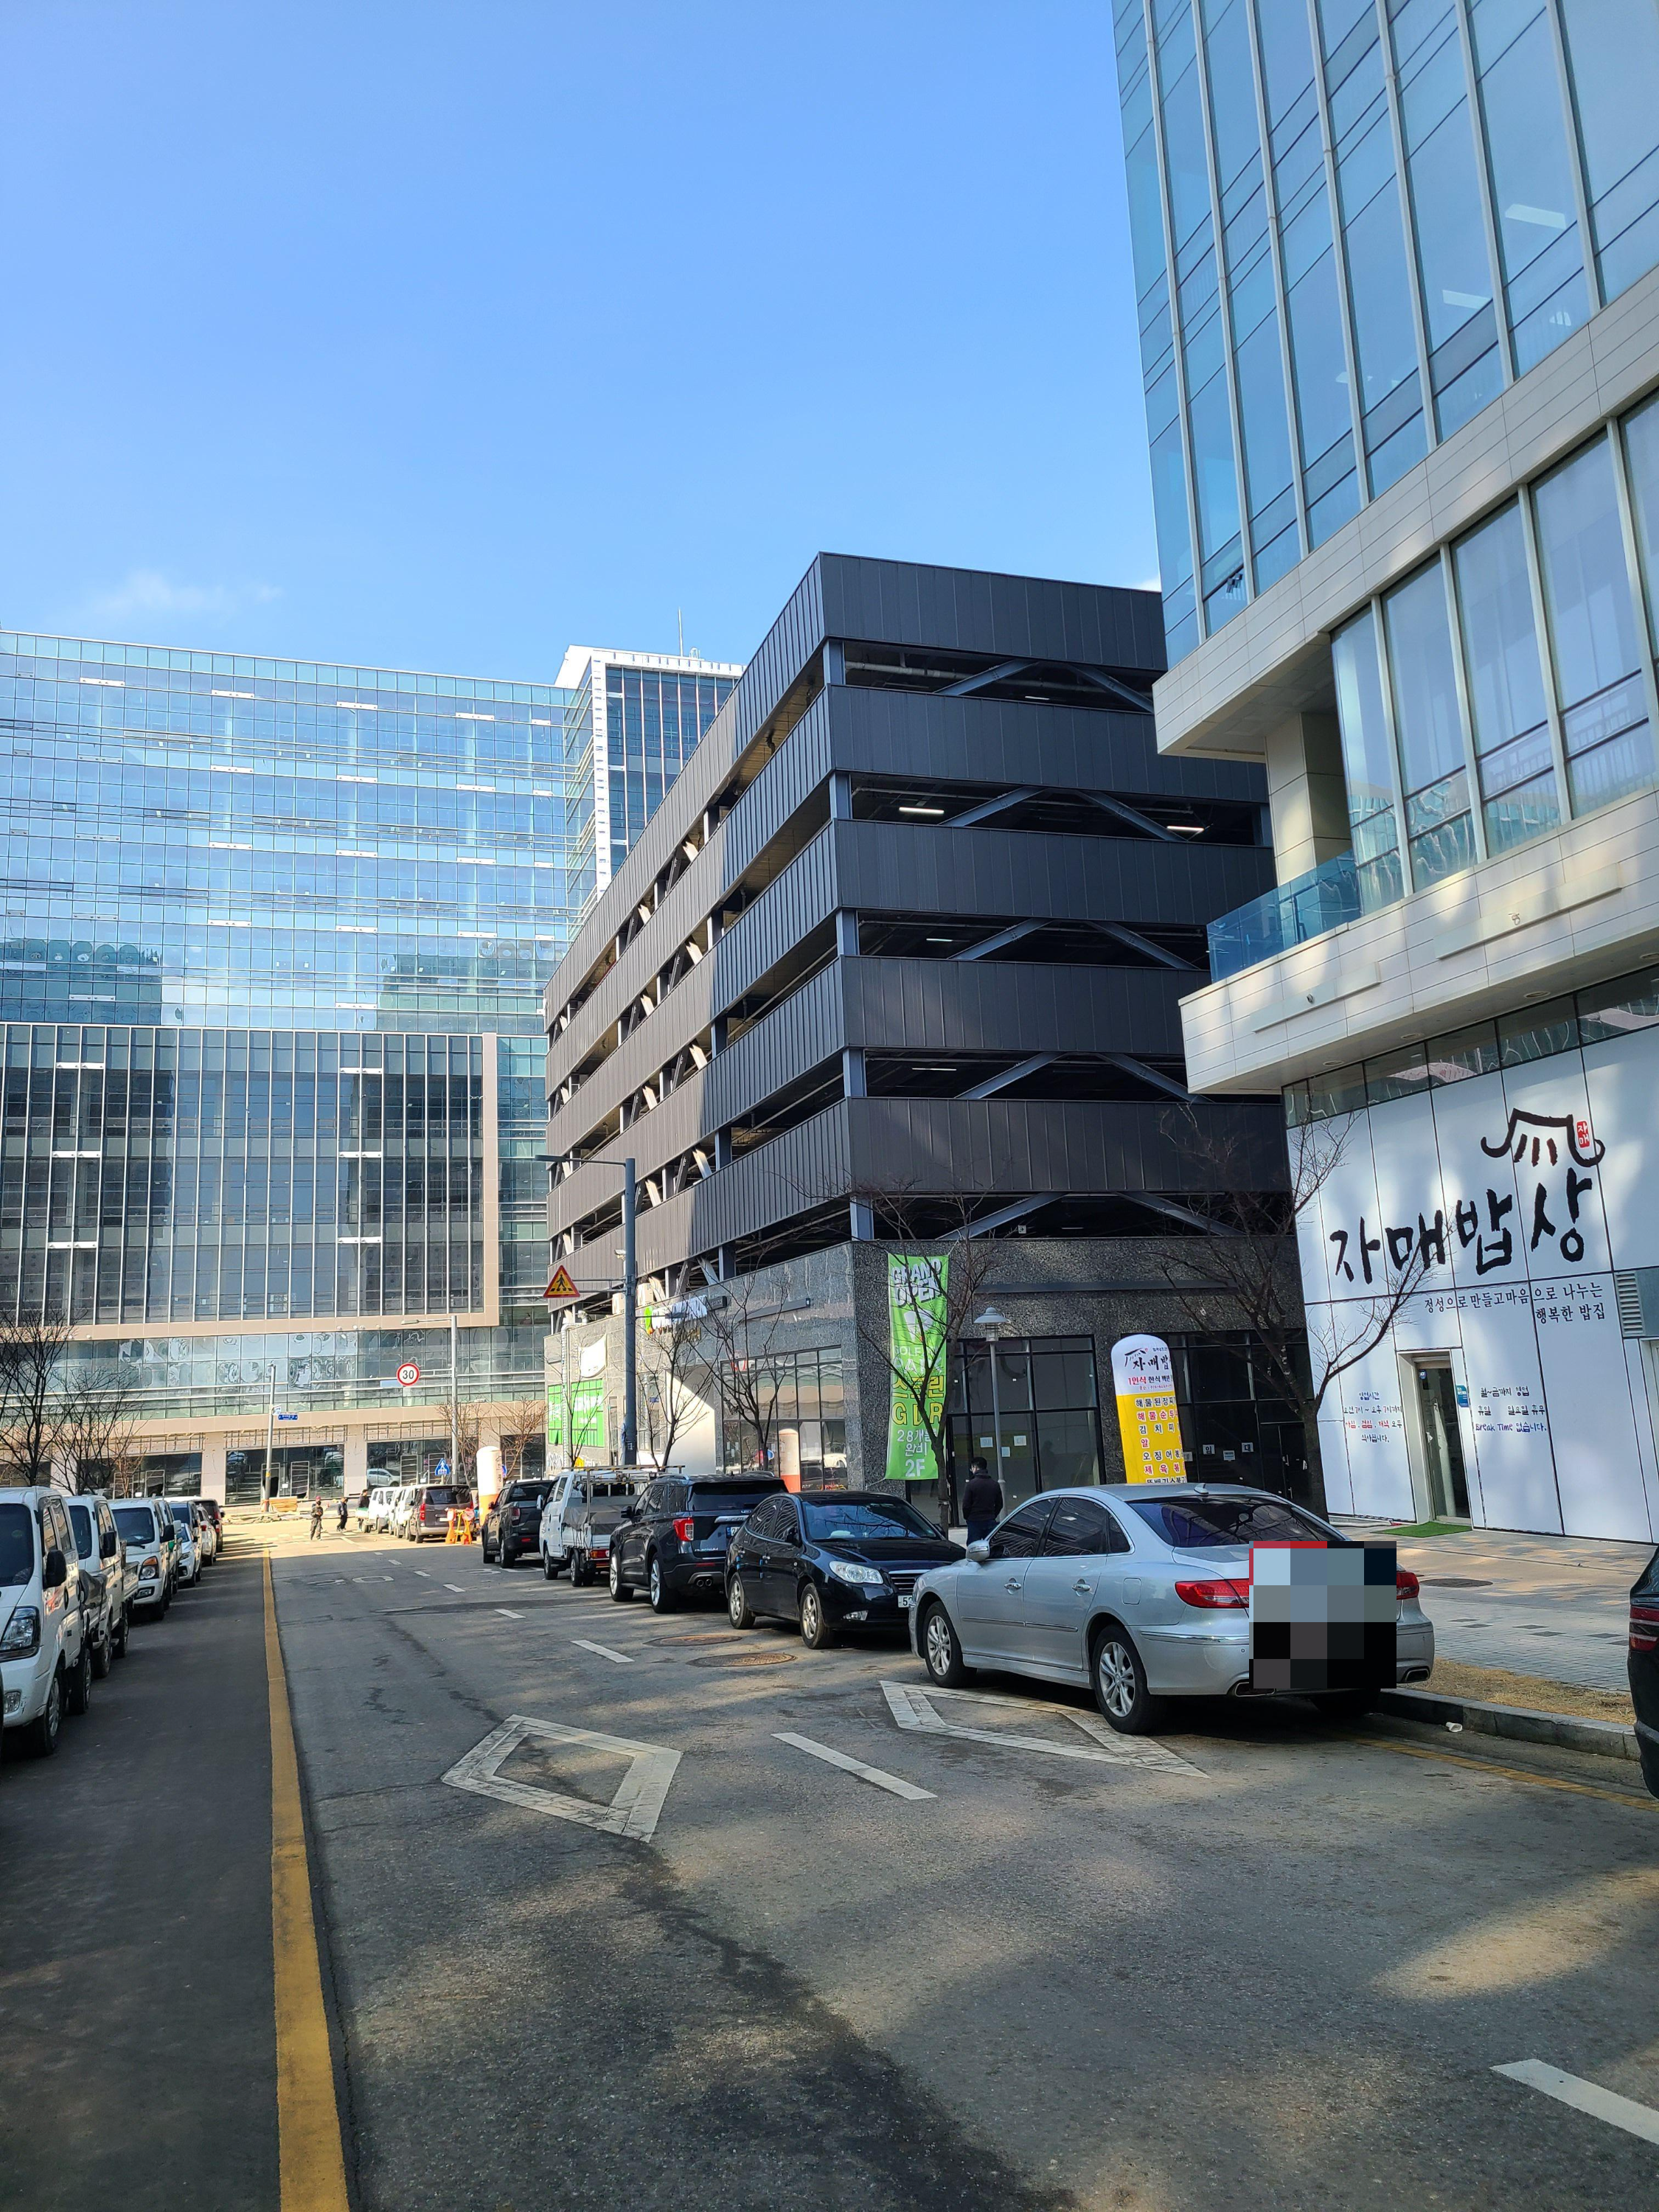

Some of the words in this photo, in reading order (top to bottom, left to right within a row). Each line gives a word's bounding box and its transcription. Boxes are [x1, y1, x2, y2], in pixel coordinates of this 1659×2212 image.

[1577, 1121, 1588, 1145] 자매
[1329, 1168, 1593, 1284] 자매밥상
[892, 1258, 942, 1284] GRAND
[894, 1278, 942, 1307] OPEN
[1562, 1281, 1603, 1301] 나누는
[1535, 1305, 1573, 1324] 행복한
[1579, 1303, 1605, 1321] 밥집
[1133, 1354, 1171, 1371] 자매밥
[403, 1370, 414, 1380] 30
[1359, 1391, 1380, 1400] 영업시간
[1516, 1386, 1530, 1397] 영업
[1478, 1405, 1492, 1416] 휴일
[1508, 1405, 1529, 1416] 일요일
[1531, 1405, 1545, 1415] 휴무
[1475, 1422, 1495, 1431] Break
[905, 1442, 928, 1458] 완비
[905, 1458, 925, 1478] 2F
[1144, 1462, 1185, 1475] 제육볶
